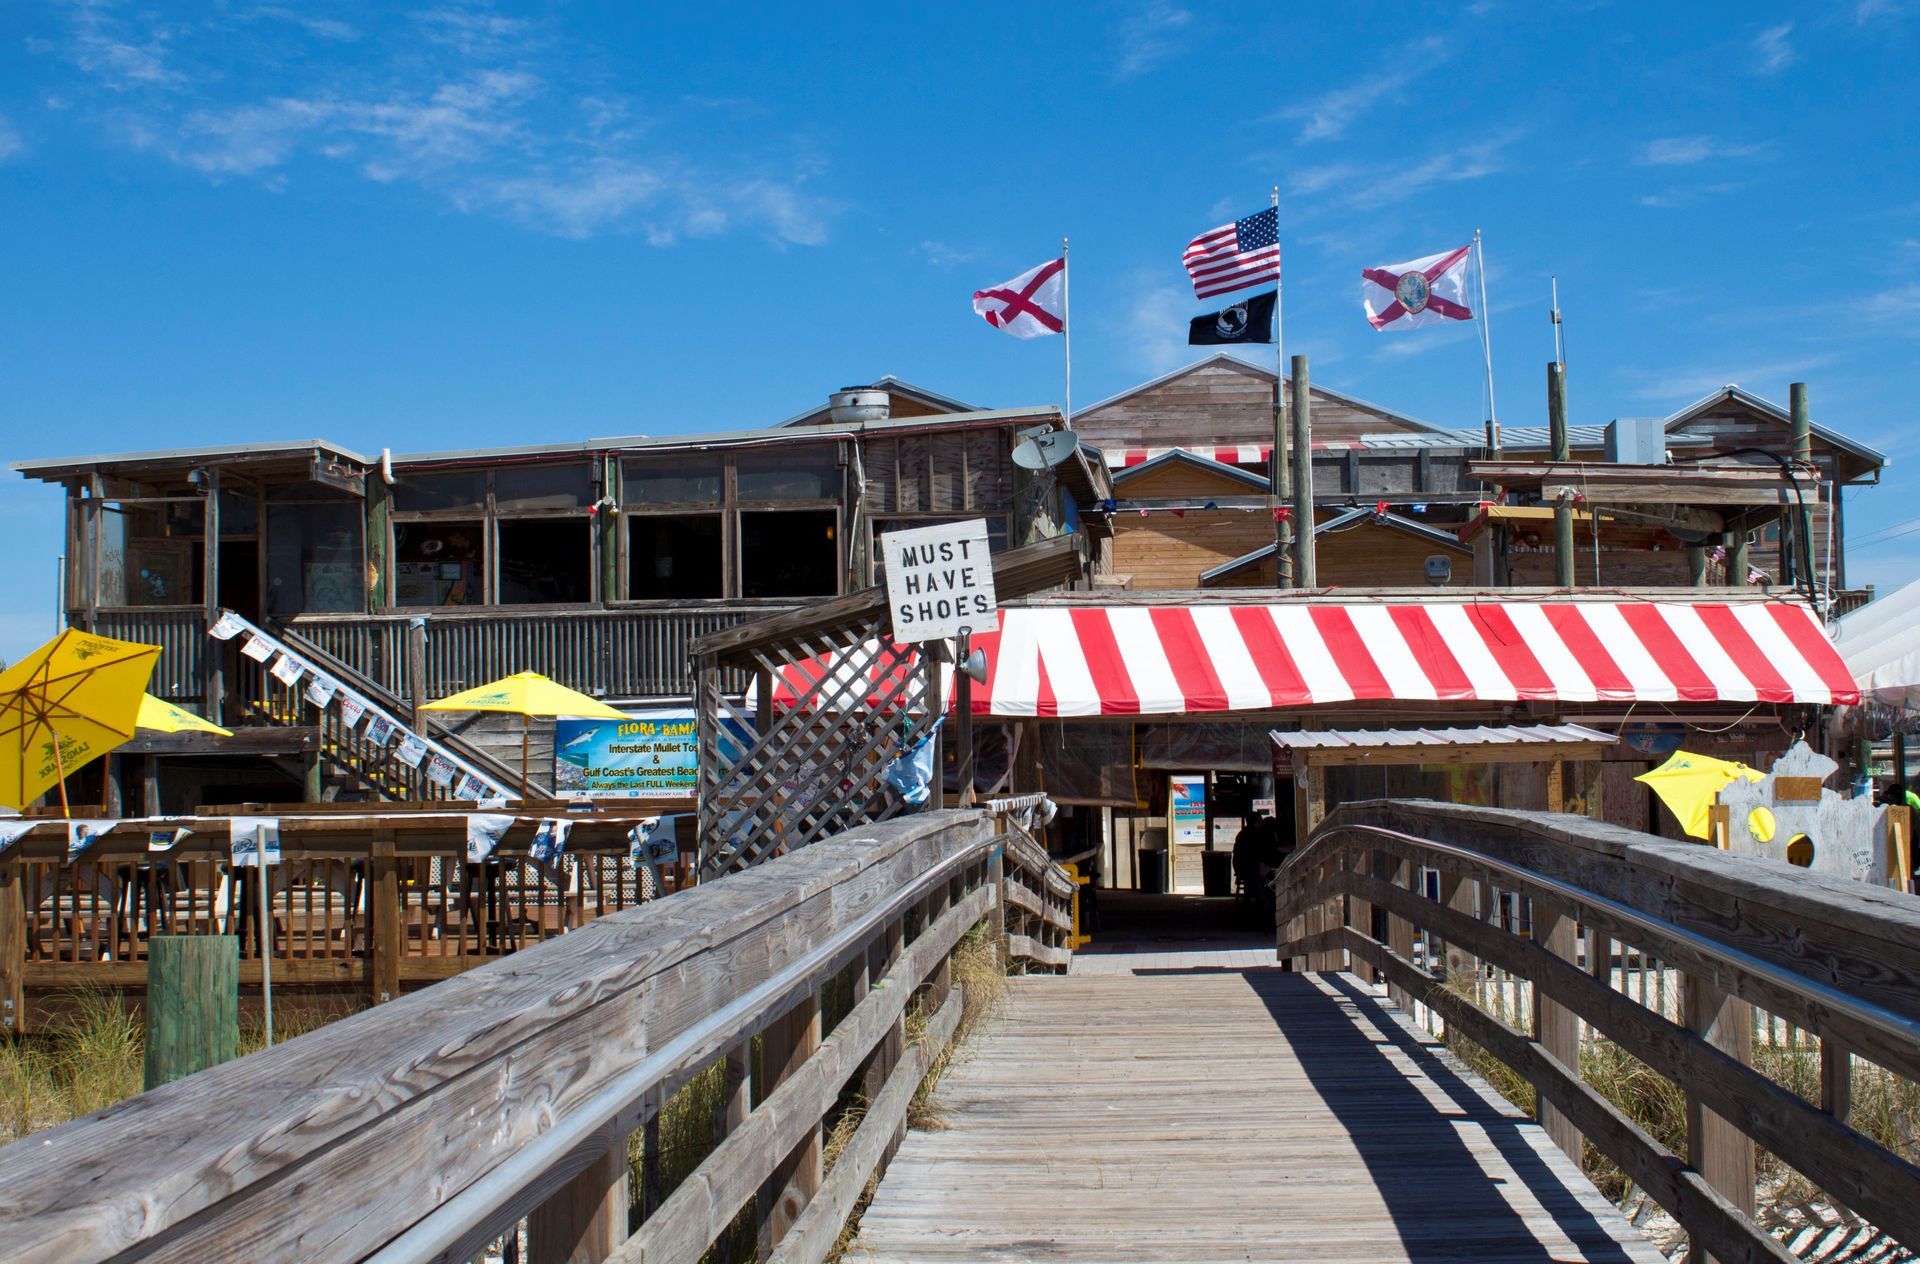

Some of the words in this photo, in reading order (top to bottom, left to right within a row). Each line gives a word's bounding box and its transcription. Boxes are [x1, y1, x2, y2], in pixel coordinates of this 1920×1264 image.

[902, 540, 971, 568] MUST
[905, 567, 976, 595] HAVE
[900, 594, 989, 624] SHOES
[342, 698, 362, 714] Coors
[609, 743, 652, 754] Interstate
[654, 742, 681, 753] Mullet
[683, 742, 698, 753] Tos
[432, 756, 454, 772] Coors
[653, 754, 660, 765] &
[583, 767, 600, 777] Gulf
[602, 766, 635, 777] Coast's
[636, 766, 674, 777] Greatest
[677, 766, 698, 776] Beac
[591, 781, 616, 790] Always
[617, 780, 629, 789] the
[630, 780, 645, 788] Last
[646, 780, 664, 788] FULL
